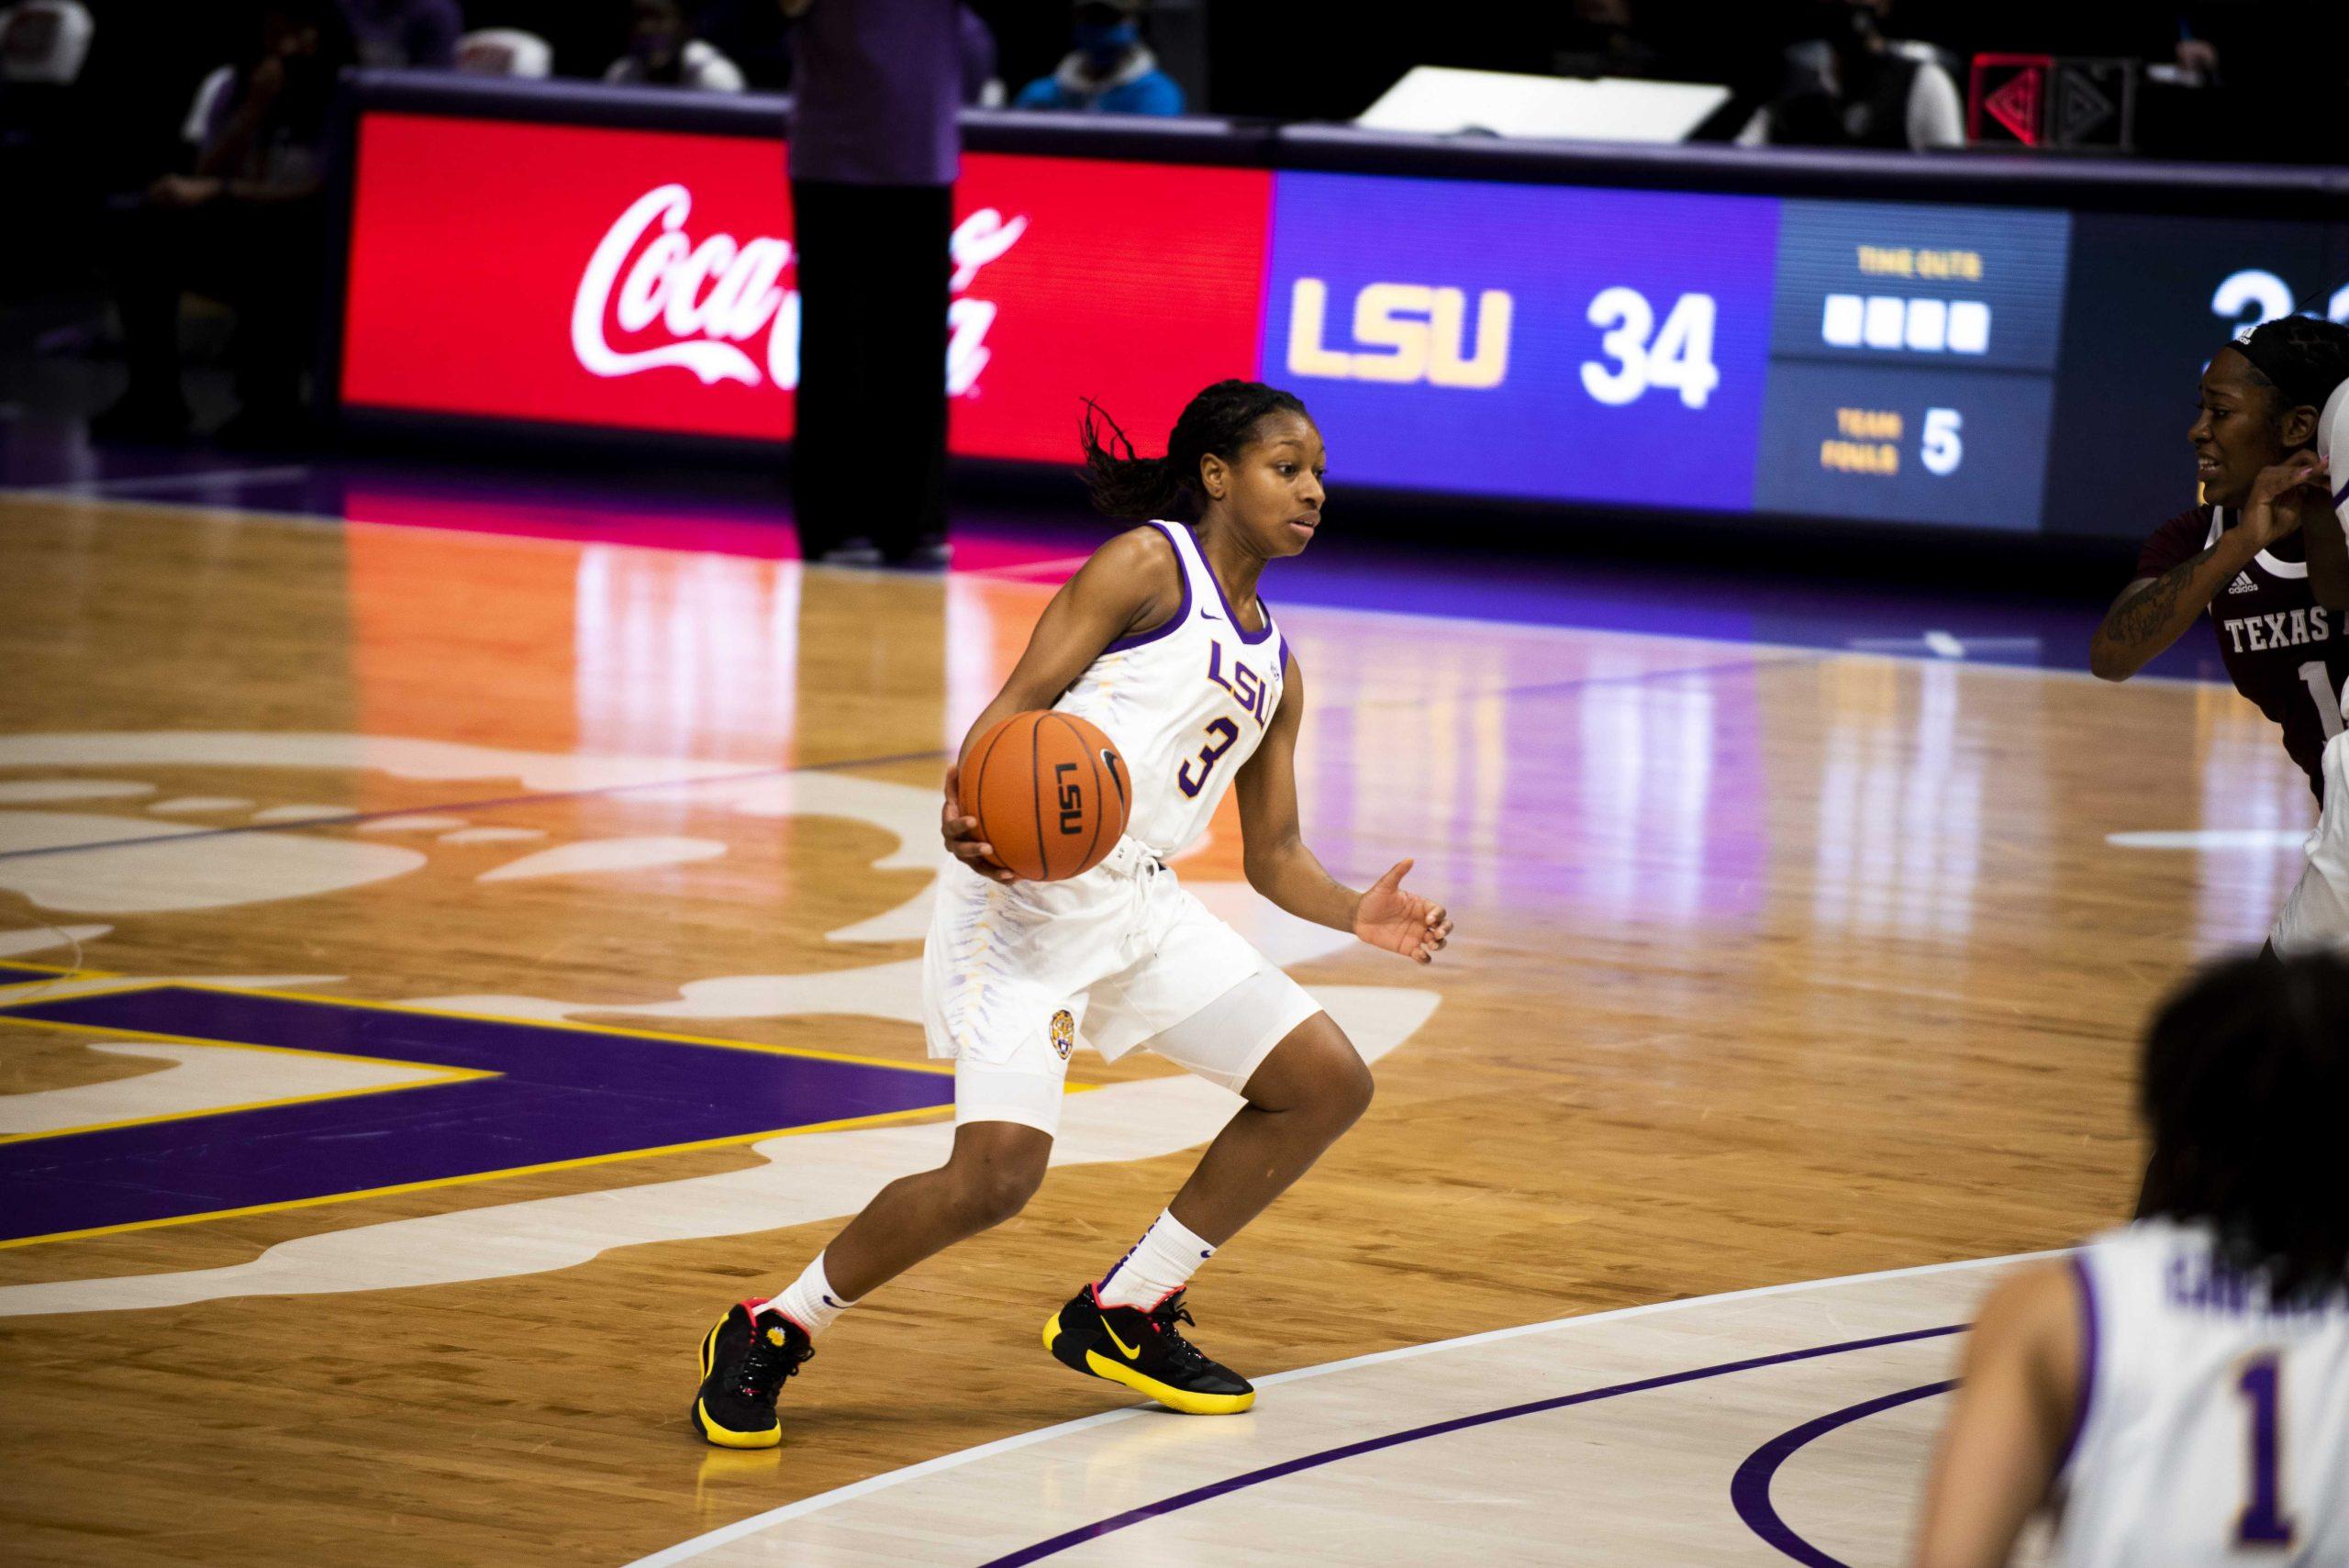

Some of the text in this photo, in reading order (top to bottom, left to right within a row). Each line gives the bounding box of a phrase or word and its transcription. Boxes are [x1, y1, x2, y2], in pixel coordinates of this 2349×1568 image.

[1286, 276, 1721, 410] LSU 34
[1920, 406, 1962, 476] 5
[2228, 583, 2259, 595] adidas
[2223, 606, 2330, 654] TEXAS
[1177, 716, 1240, 801] 3
[1055, 762, 1083, 836] LSU
[2230, 1347, 2298, 1552] 1
